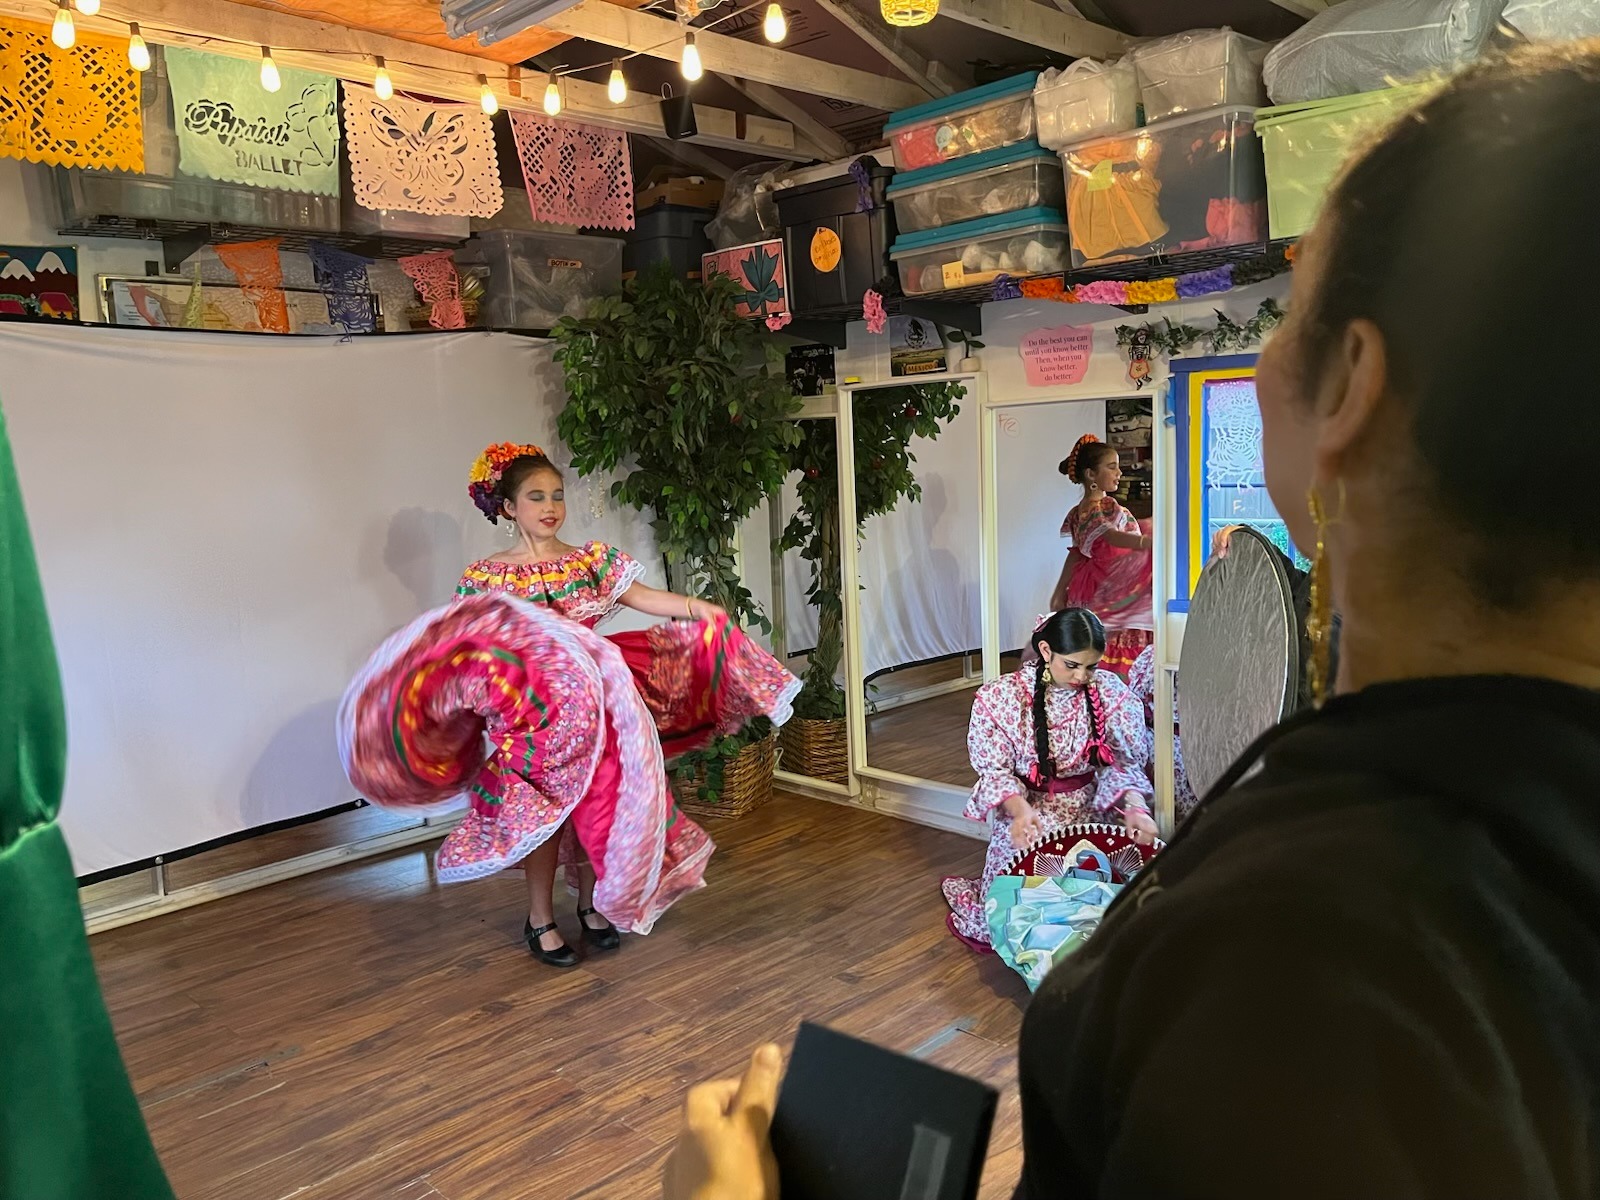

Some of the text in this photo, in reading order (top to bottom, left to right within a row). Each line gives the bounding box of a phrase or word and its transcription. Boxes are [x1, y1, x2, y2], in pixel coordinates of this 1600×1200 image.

[235, 150, 303, 176] BALLET
[1039, 338, 1048, 346] the
[1049, 337, 1062, 345] best
[1064, 336, 1075, 344] you
[1025, 348, 1039, 356] until
[1053, 355, 1070, 363] when
[1070, 354, 1082, 363] you
